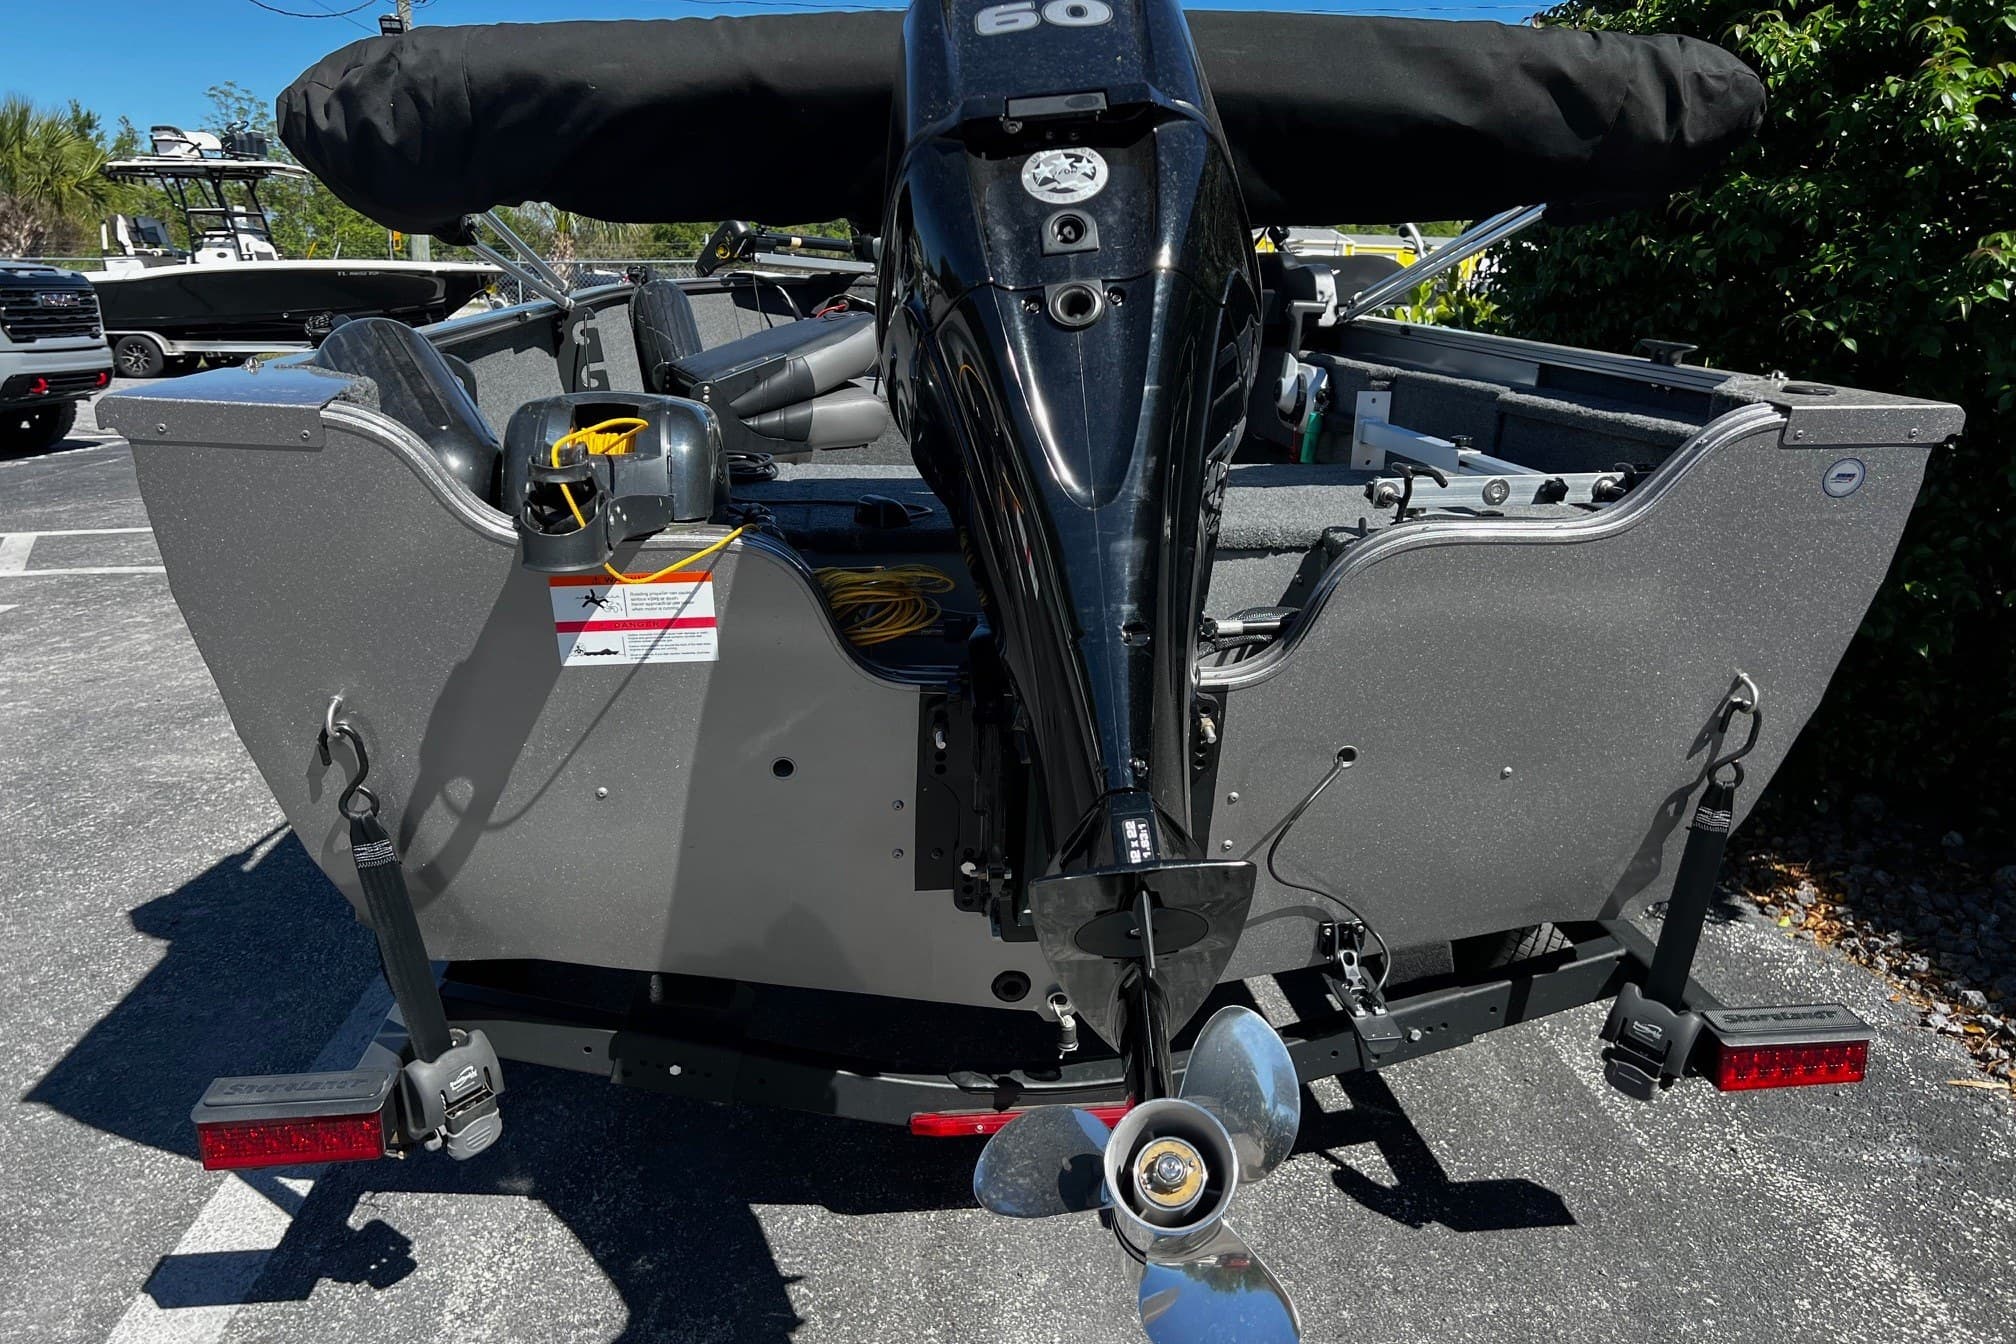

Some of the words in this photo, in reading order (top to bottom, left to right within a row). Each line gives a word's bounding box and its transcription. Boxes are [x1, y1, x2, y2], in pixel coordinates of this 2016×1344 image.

[974, 0, 1113, 36] 60
[614, 621, 660, 629] DANGER
[1125, 821, 1137, 839] 22
